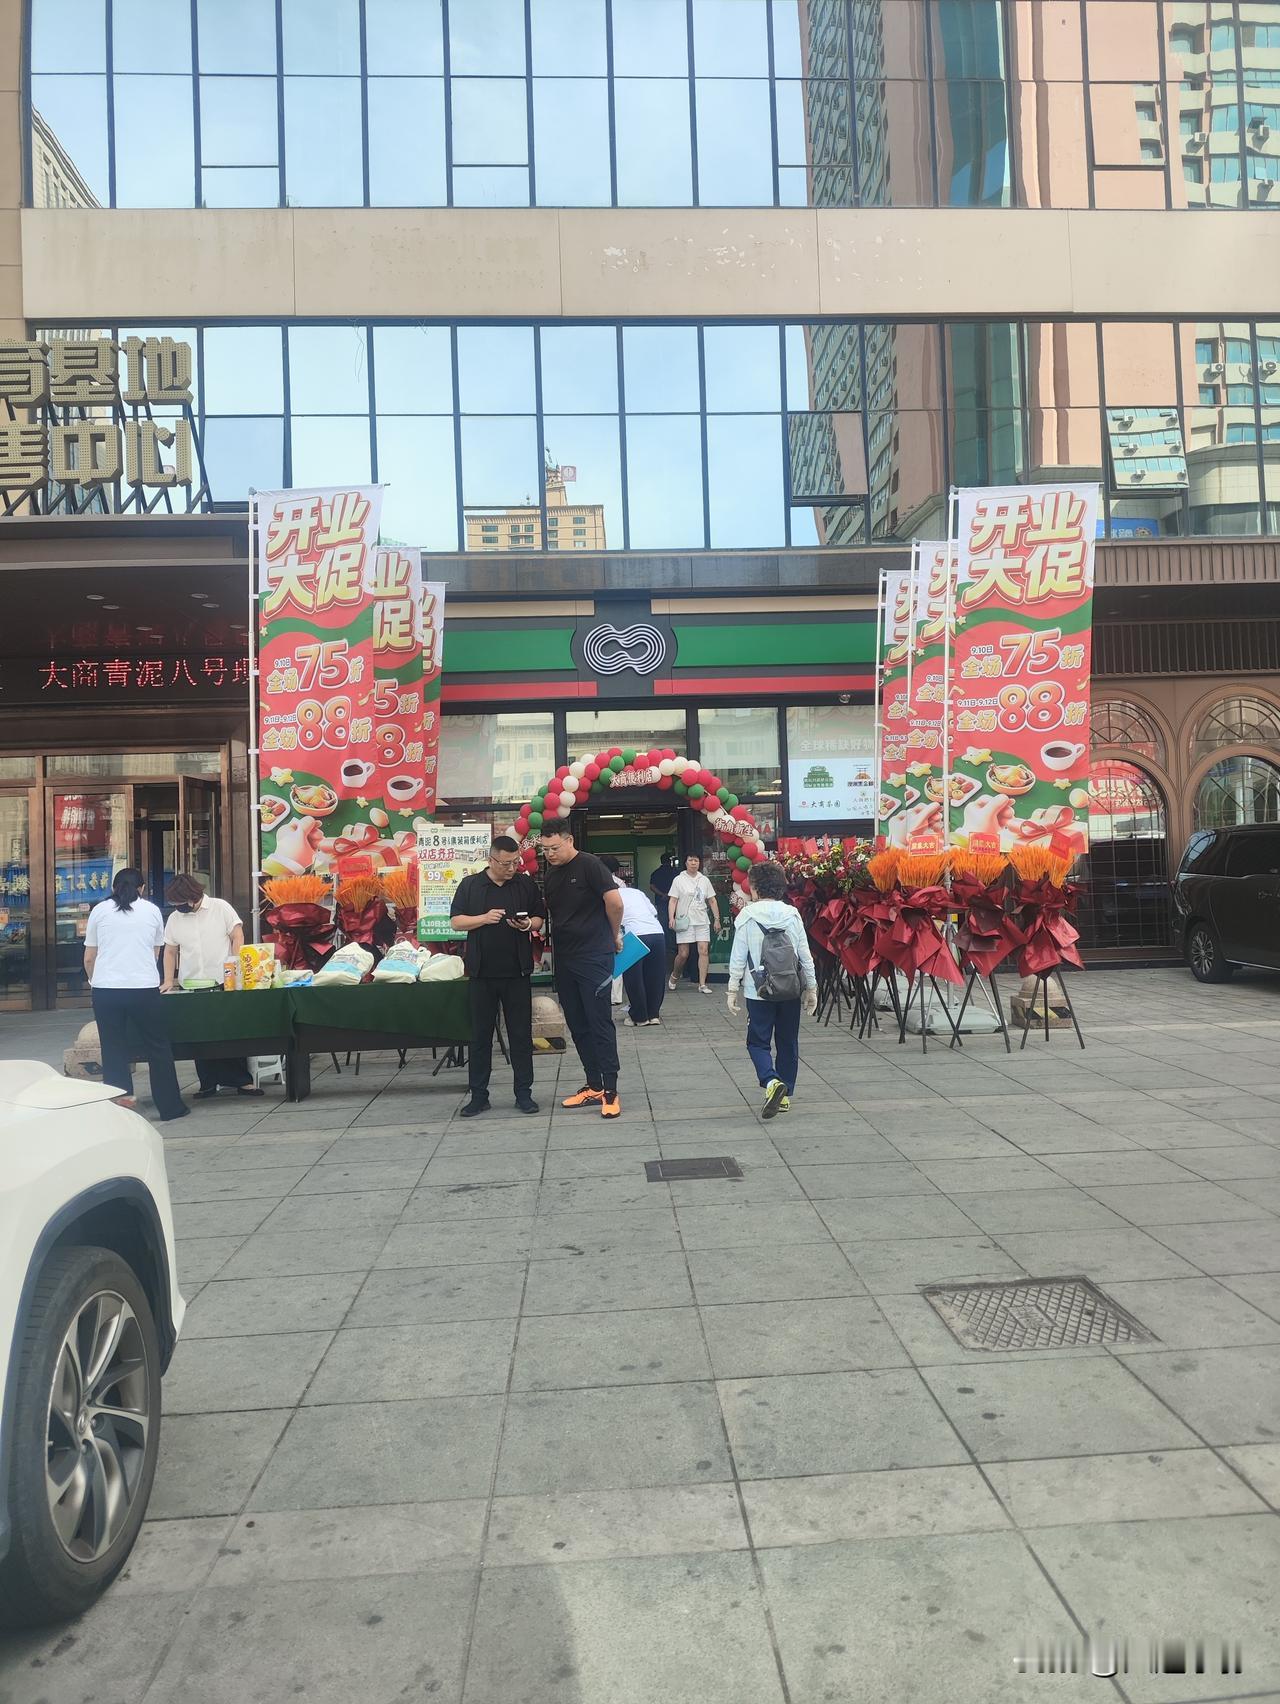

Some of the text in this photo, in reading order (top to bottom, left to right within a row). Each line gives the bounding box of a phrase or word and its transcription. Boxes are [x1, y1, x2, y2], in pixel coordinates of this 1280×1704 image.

[267, 492, 370, 561] 开业
[968, 491, 1087, 553] 开业
[264, 543, 366, 618] 大促
[961, 540, 1086, 609] 大促
[971, 646, 993, 655] 9.10日
